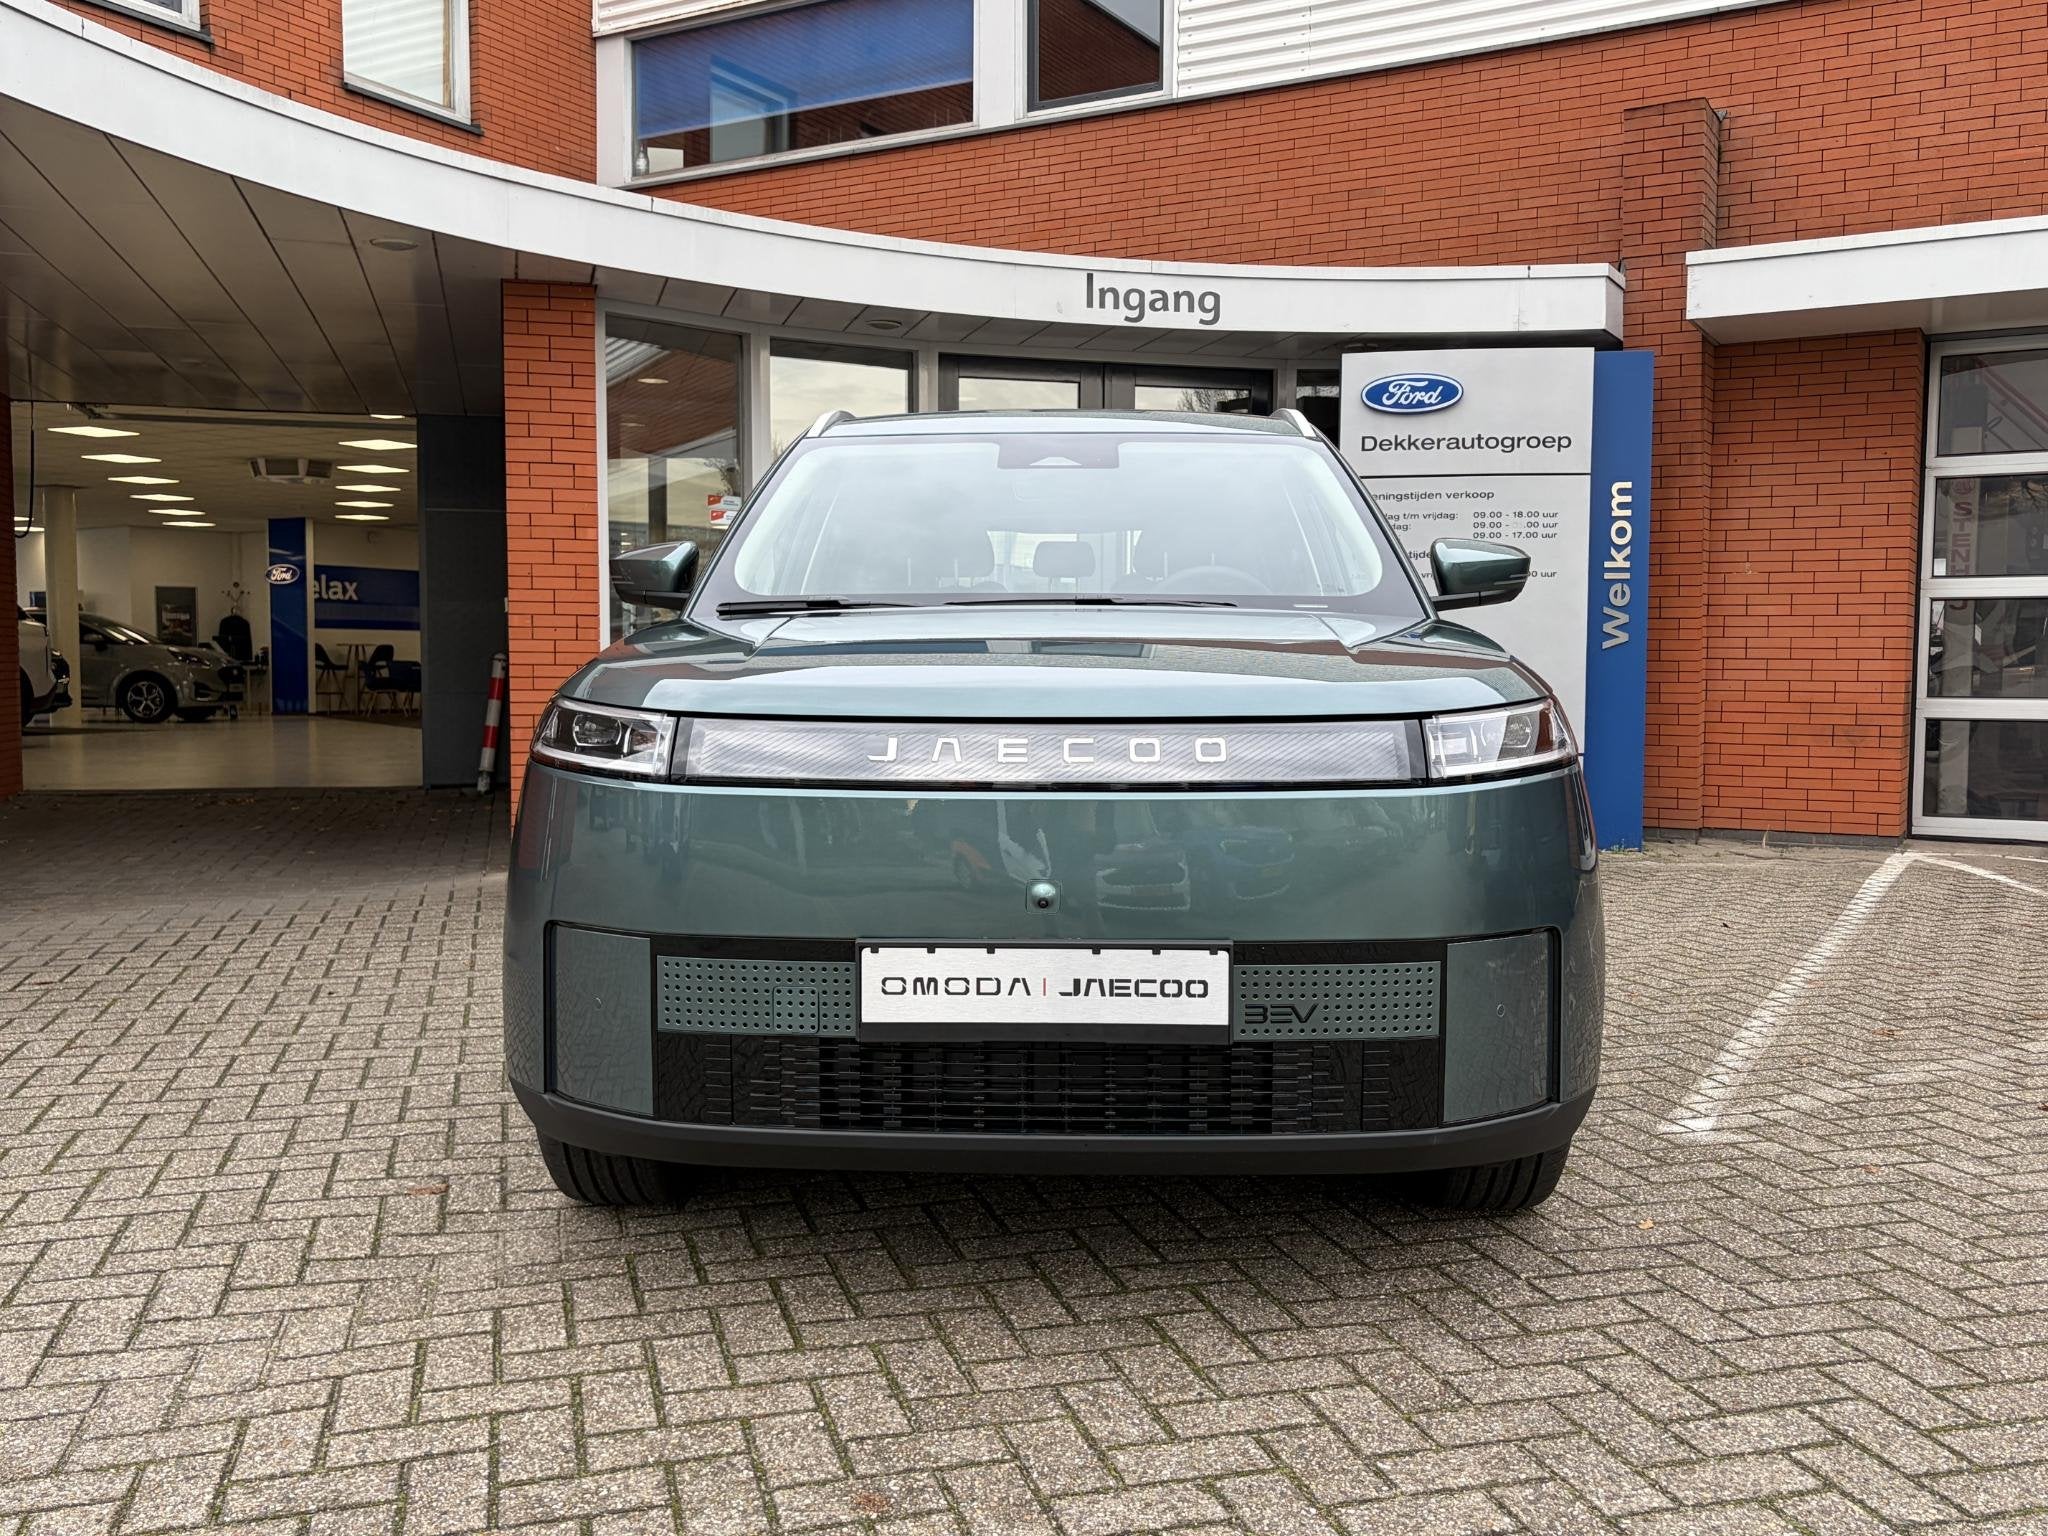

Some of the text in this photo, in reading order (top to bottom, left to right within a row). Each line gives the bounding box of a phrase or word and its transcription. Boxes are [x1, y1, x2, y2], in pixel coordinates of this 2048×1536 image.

[1086, 273, 1221, 325] Ingang
[1381, 380, 1443, 405] Ford
[1361, 433, 1572, 453] Dekkerautogroep
[1371, 491, 1495, 502] eningstijden verkoop
[1403, 512, 1420, 520] t/m
[1423, 511, 1459, 521] vrijdag:
[1473, 511, 1503, 519] 09.00
[1512, 510, 1540, 519] 18.00
[1473, 521, 1502, 529] 09.00
[1473, 531, 1502, 539] 09.00
[1512, 531, 1539, 539] 17.00
[1601, 481, 1633, 649] Welkom
[1948, 501, 1972, 611] STENHJ
[313, 574, 358, 600] elax
[867, 736, 1227, 763] JAECOO
[881, 976, 1209, 998] OMODA JAECOO
[1244, 1003, 1319, 1024] BEV
